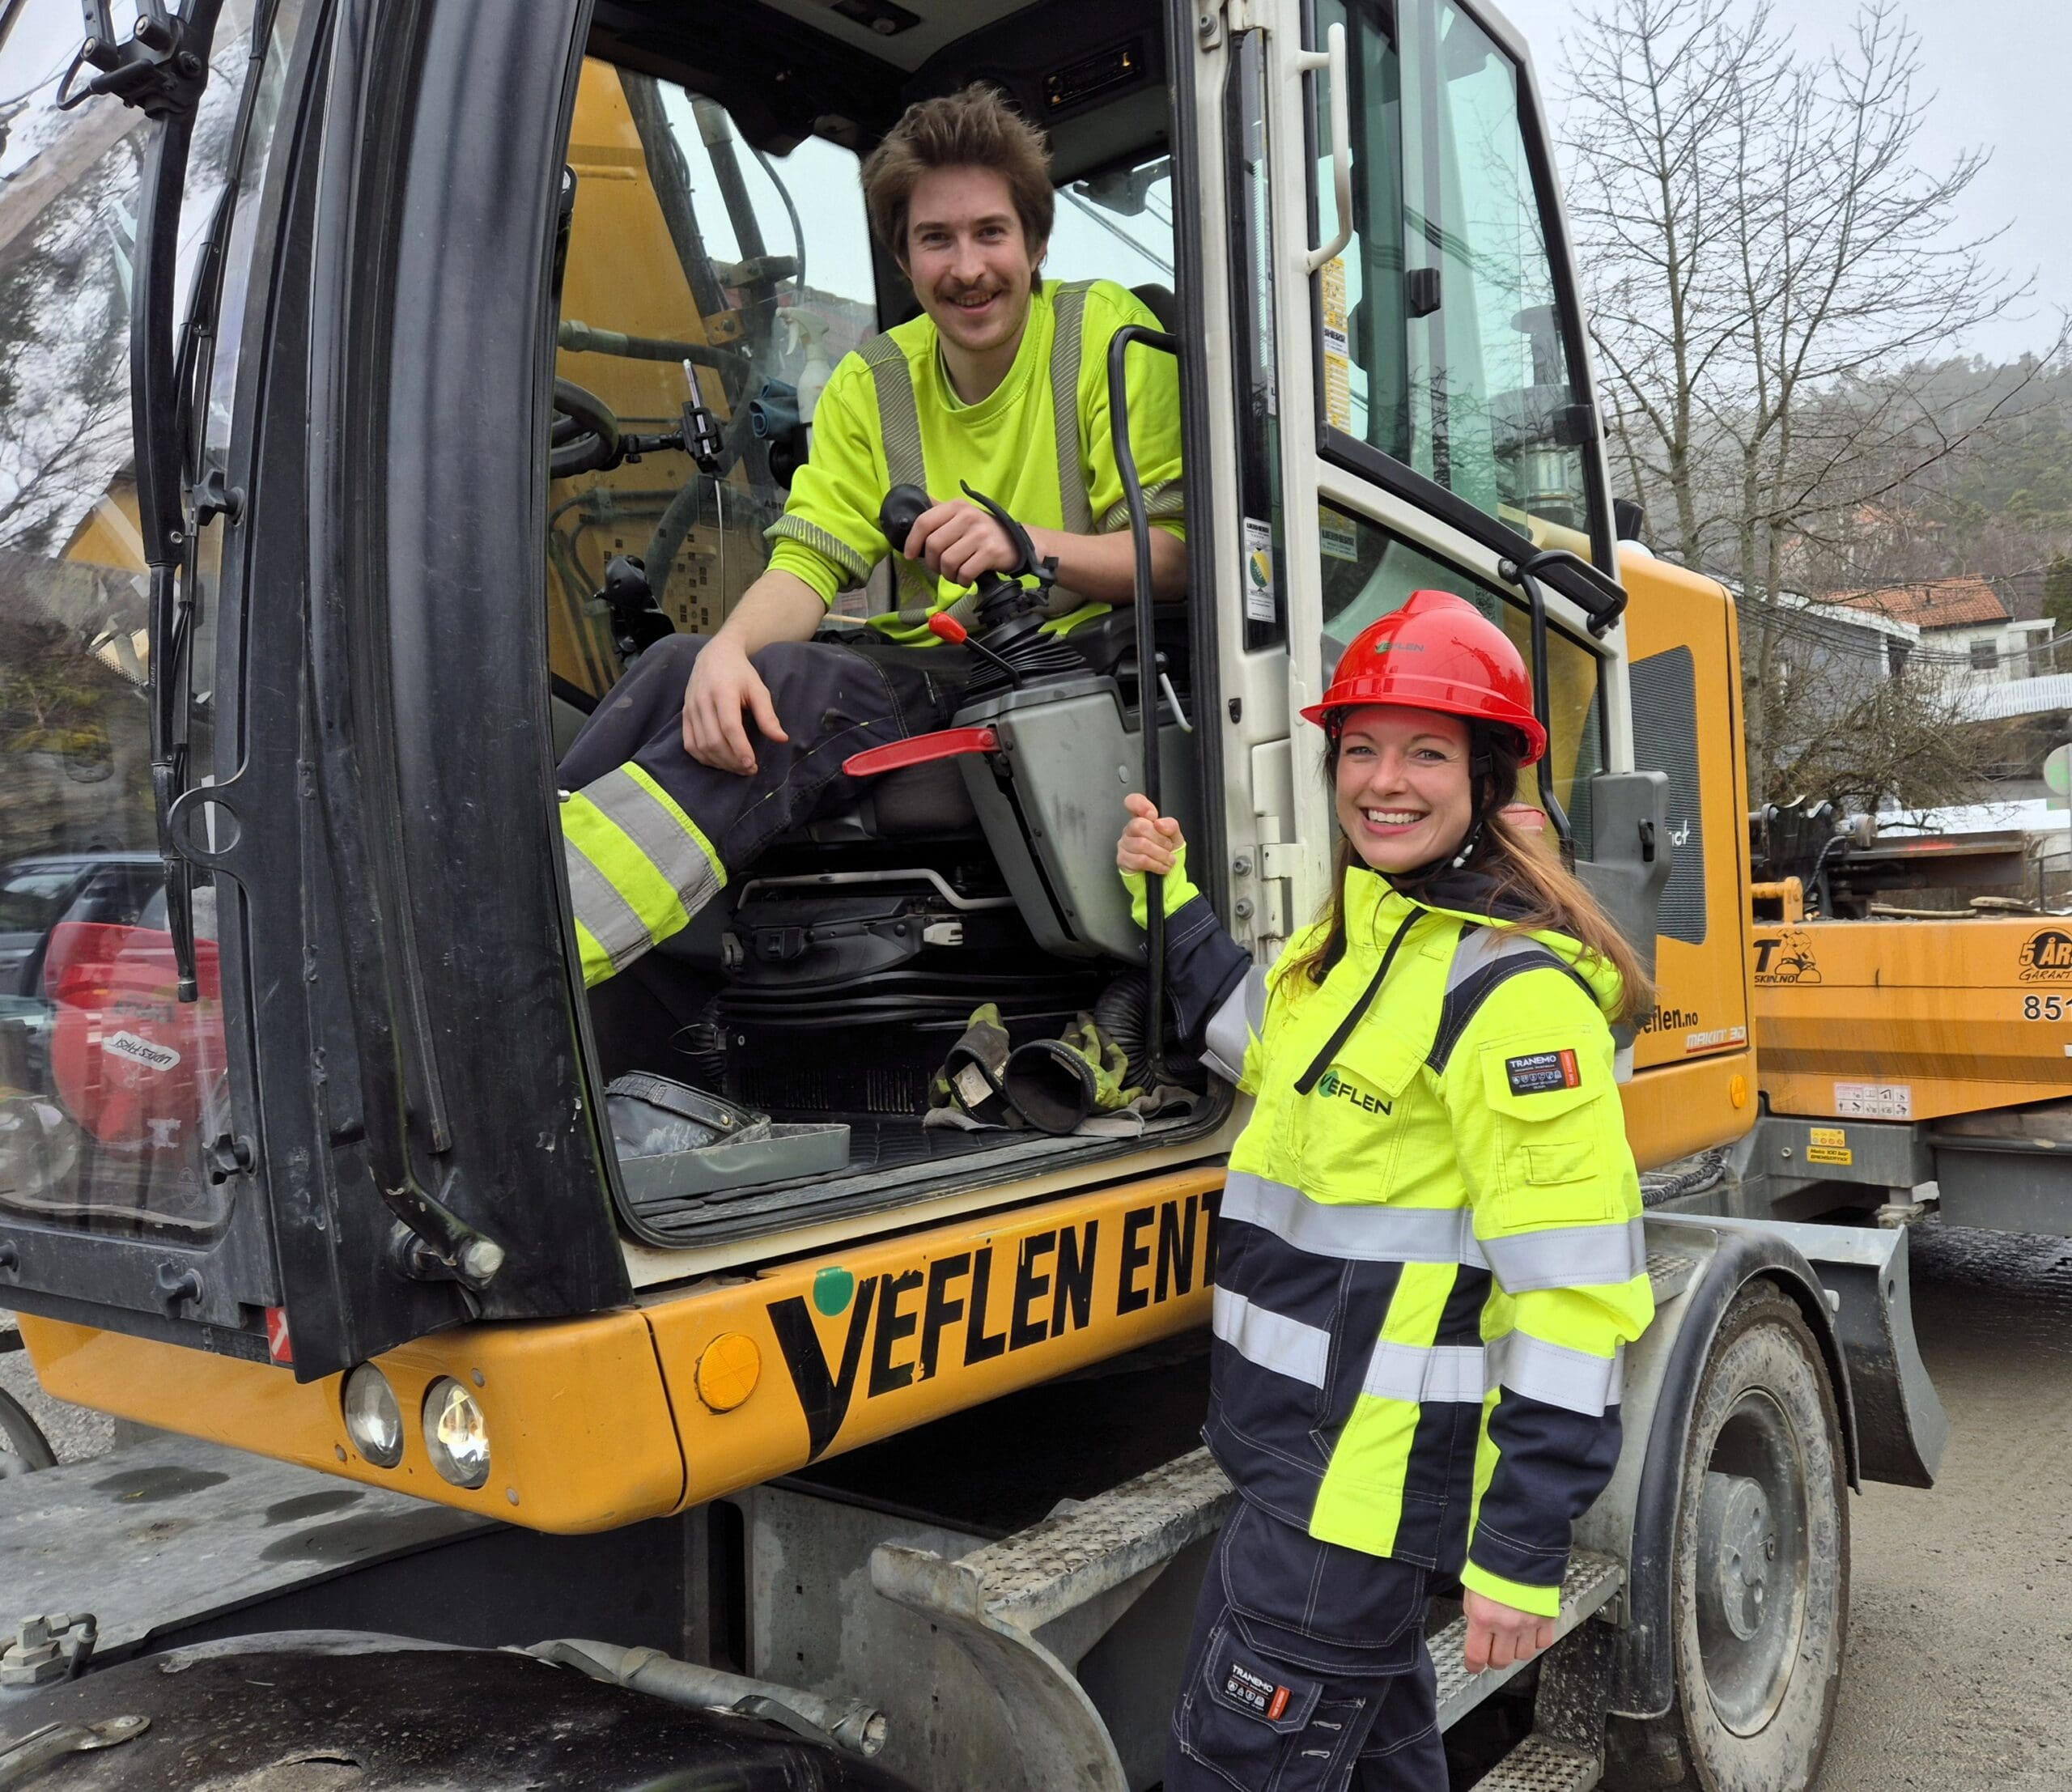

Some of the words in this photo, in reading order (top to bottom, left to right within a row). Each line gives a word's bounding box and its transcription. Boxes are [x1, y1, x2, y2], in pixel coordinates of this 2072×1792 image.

[2019, 943, 2036, 966] 5
[2038, 936, 2072, 966] ÅR
[1638, 1004, 1698, 1034] eflen.no
[1509, 1055, 1556, 1068] TRANEMO
[1320, 1073, 1393, 1116] VEFLEN
[766, 1220, 1098, 1467] VEFLEN
[1232, 1664, 1273, 1692] TRANEMO
